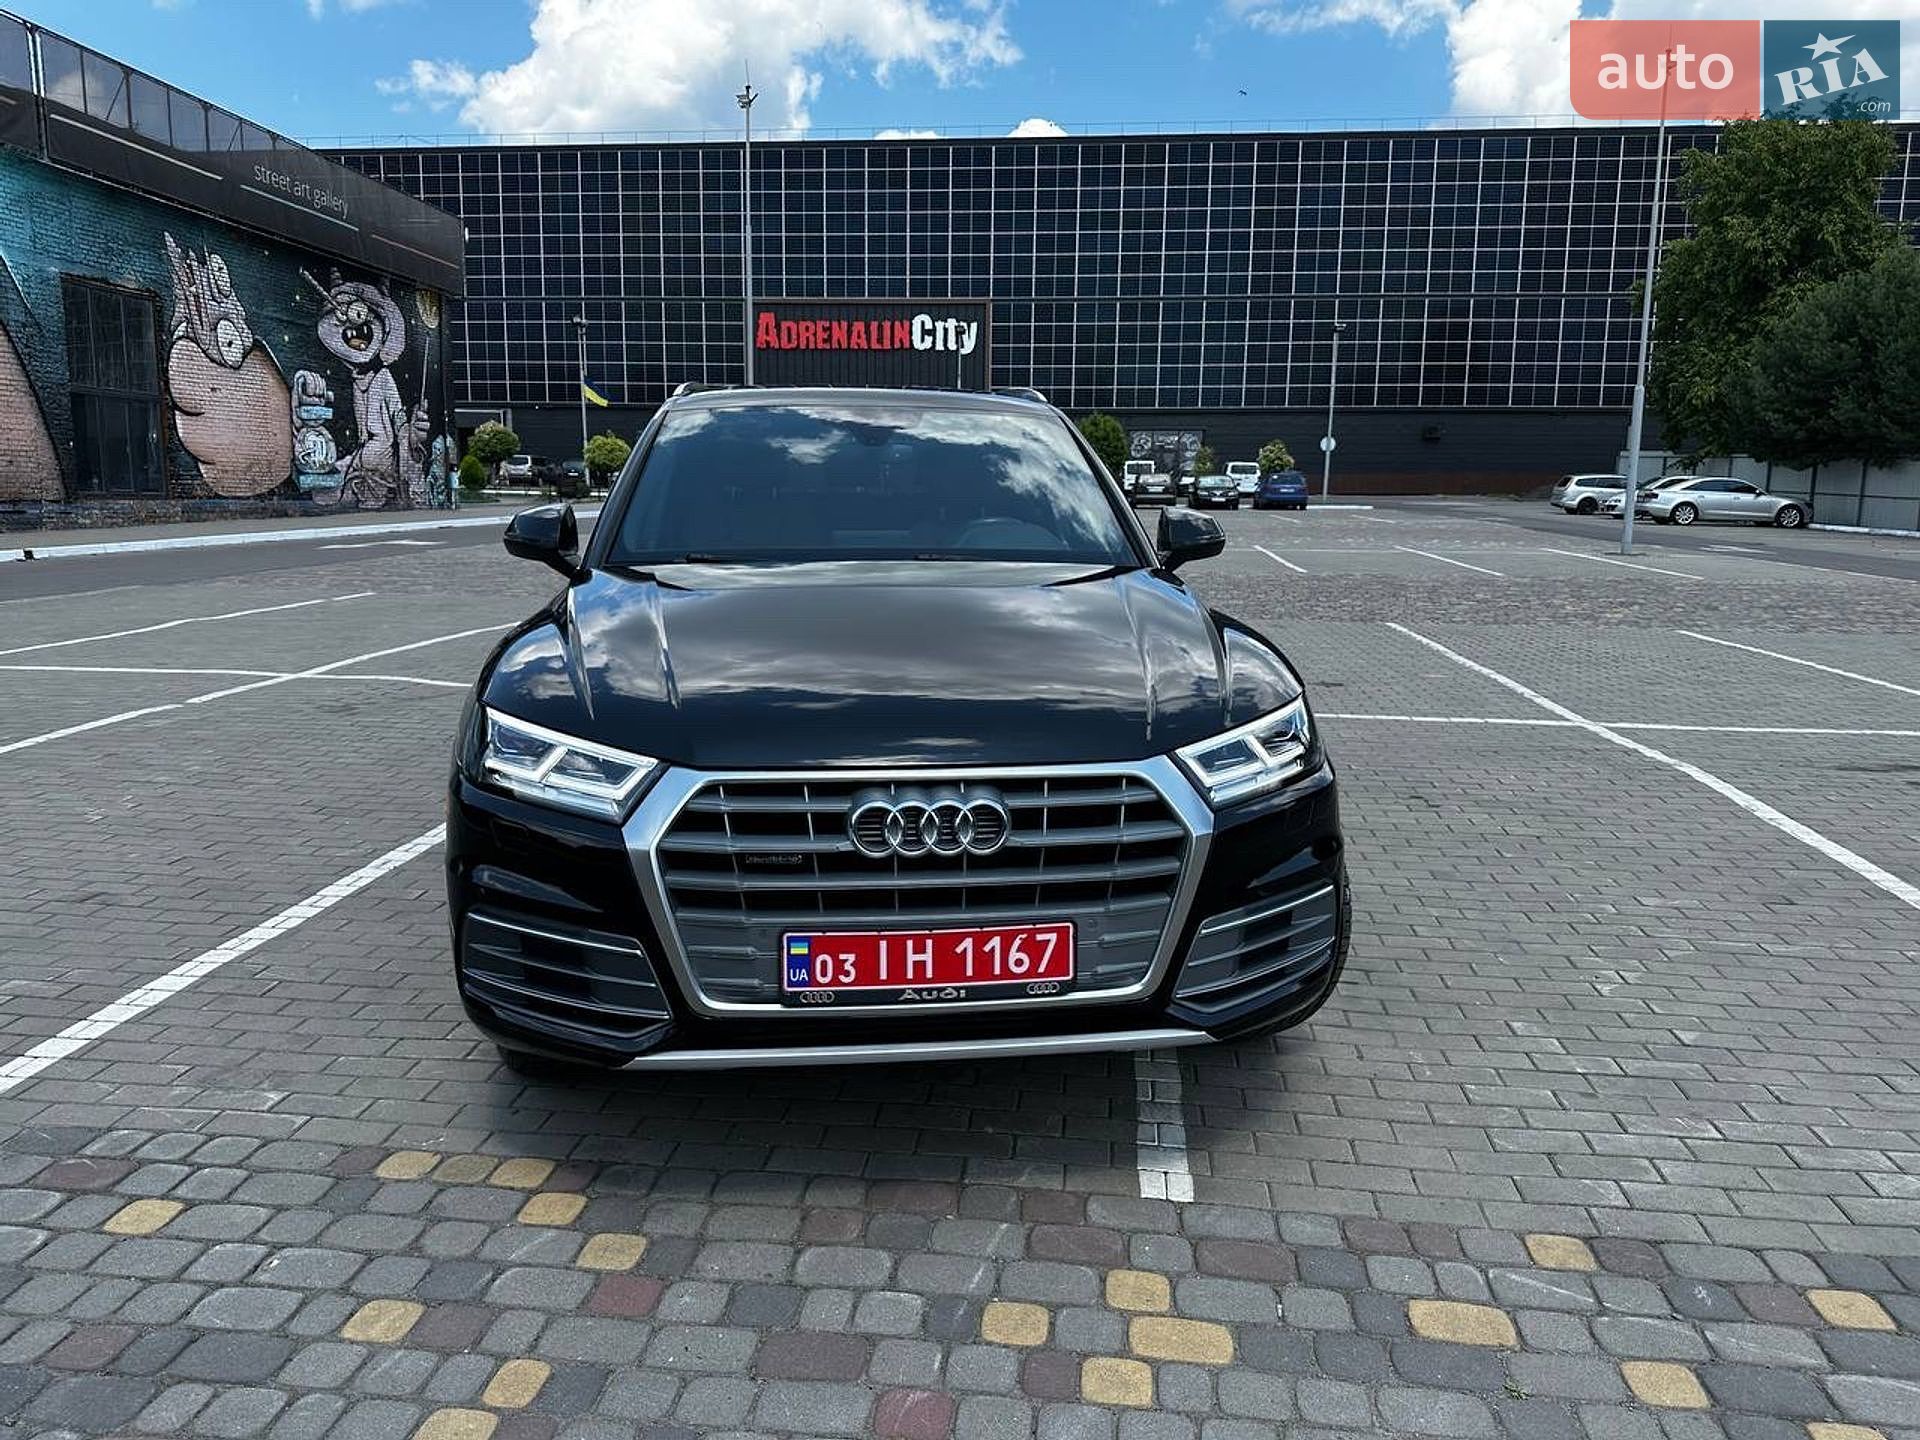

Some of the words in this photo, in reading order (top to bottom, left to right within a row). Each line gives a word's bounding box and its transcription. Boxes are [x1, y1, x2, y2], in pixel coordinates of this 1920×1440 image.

[254, 164, 290, 193] street
[293, 181, 311, 200] art
[313, 182, 348, 219] gallery
[790, 968, 809, 981] UA
[815, 953, 857, 984] 03
[955, 932, 1057, 977] 1167
[899, 987, 966, 1000] Audi
